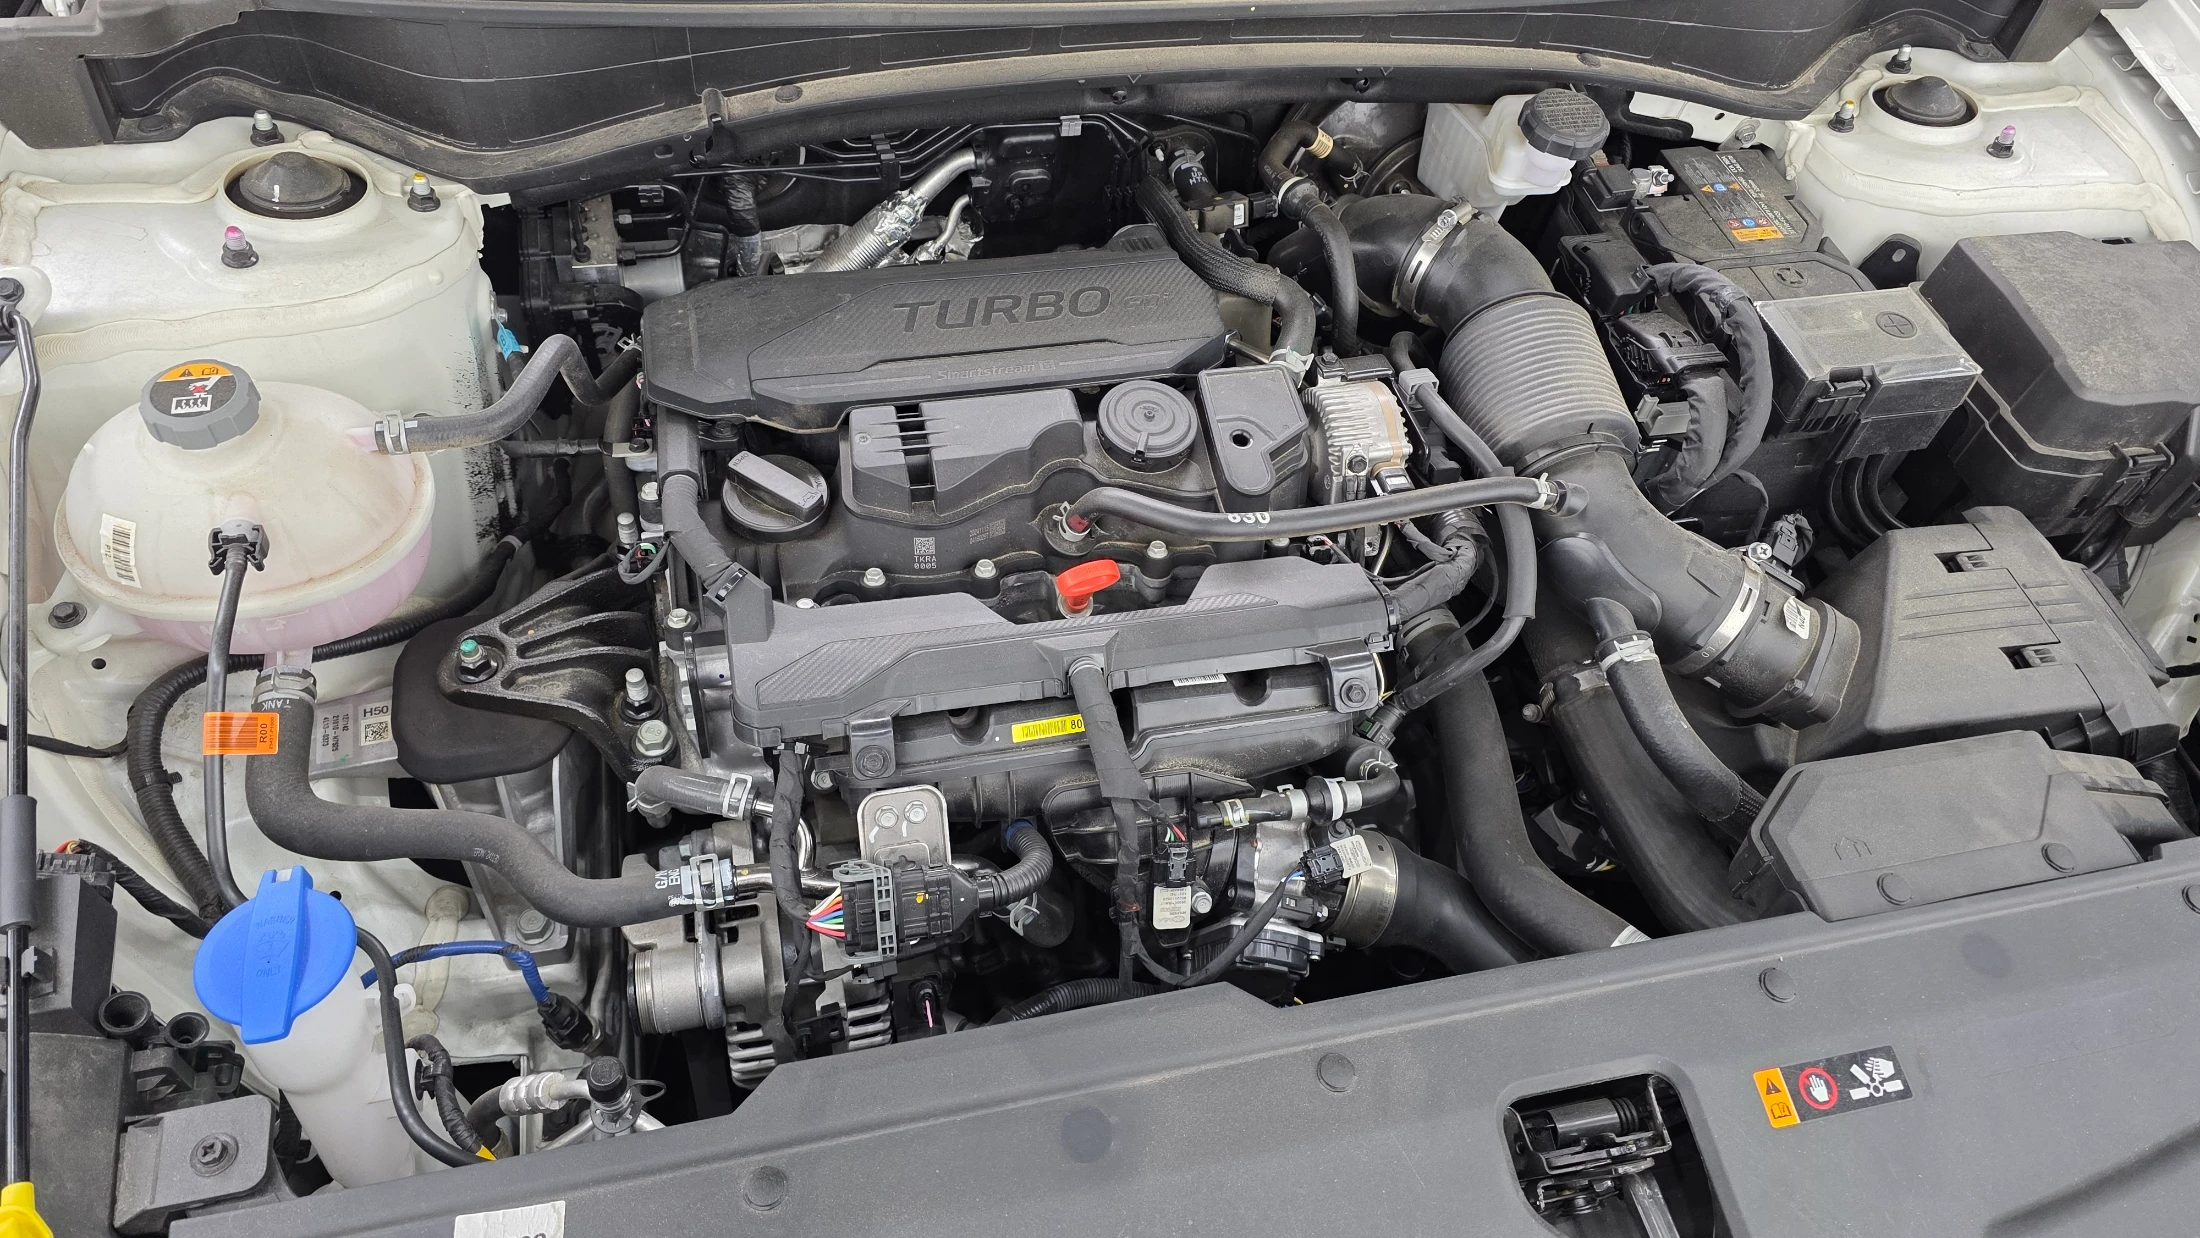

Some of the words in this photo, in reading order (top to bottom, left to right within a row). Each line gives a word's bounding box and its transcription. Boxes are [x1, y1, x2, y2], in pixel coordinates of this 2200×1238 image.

[893, 286, 1111, 333] TURBO
[936, 363, 1035, 381] Smartstream
[733, 452, 749, 467] OPEN
[913, 555, 937, 563] TKRA
[262, 699, 292, 711] TANK
[363, 705, 389, 718] H50
[259, 723, 268, 744] R00
[669, 868, 680, 886] ENG
